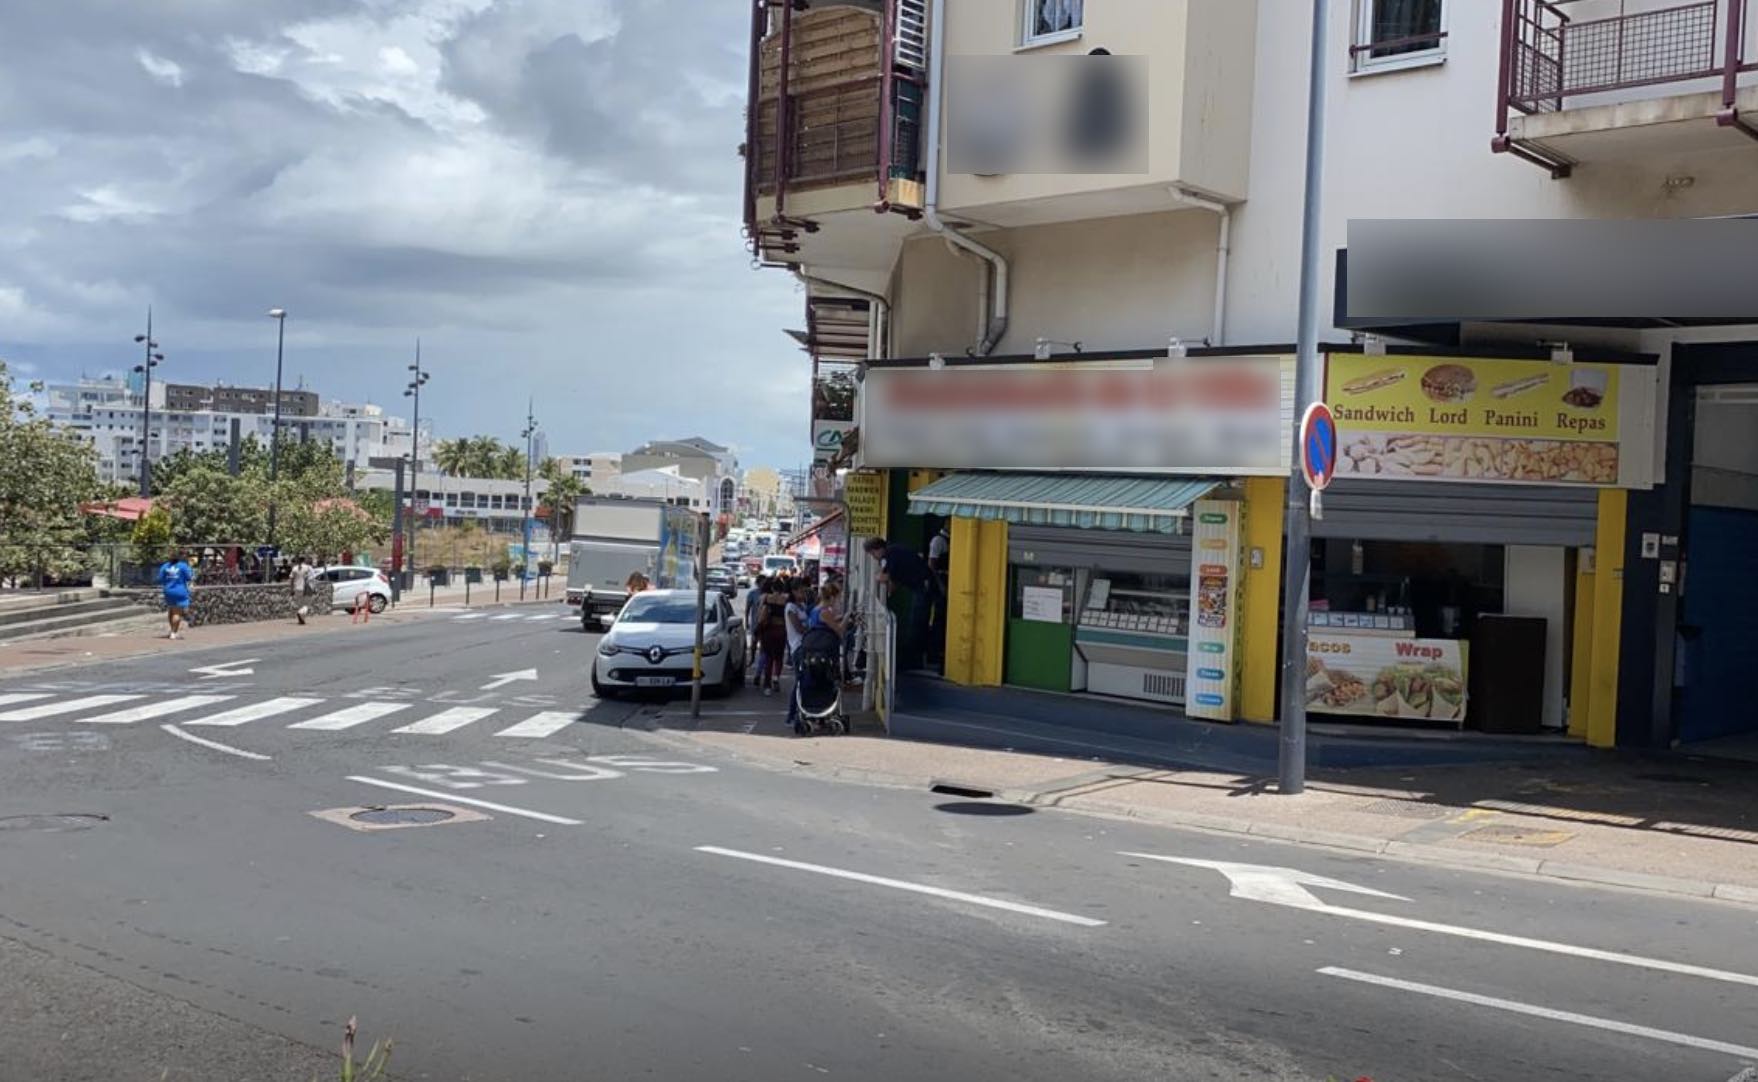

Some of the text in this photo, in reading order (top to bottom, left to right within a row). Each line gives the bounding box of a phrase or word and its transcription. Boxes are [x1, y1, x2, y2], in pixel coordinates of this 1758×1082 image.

[1333, 403, 1606, 433] Sandwich Lord Panini Repas
[1308, 641, 1444, 660] acos Wrap
